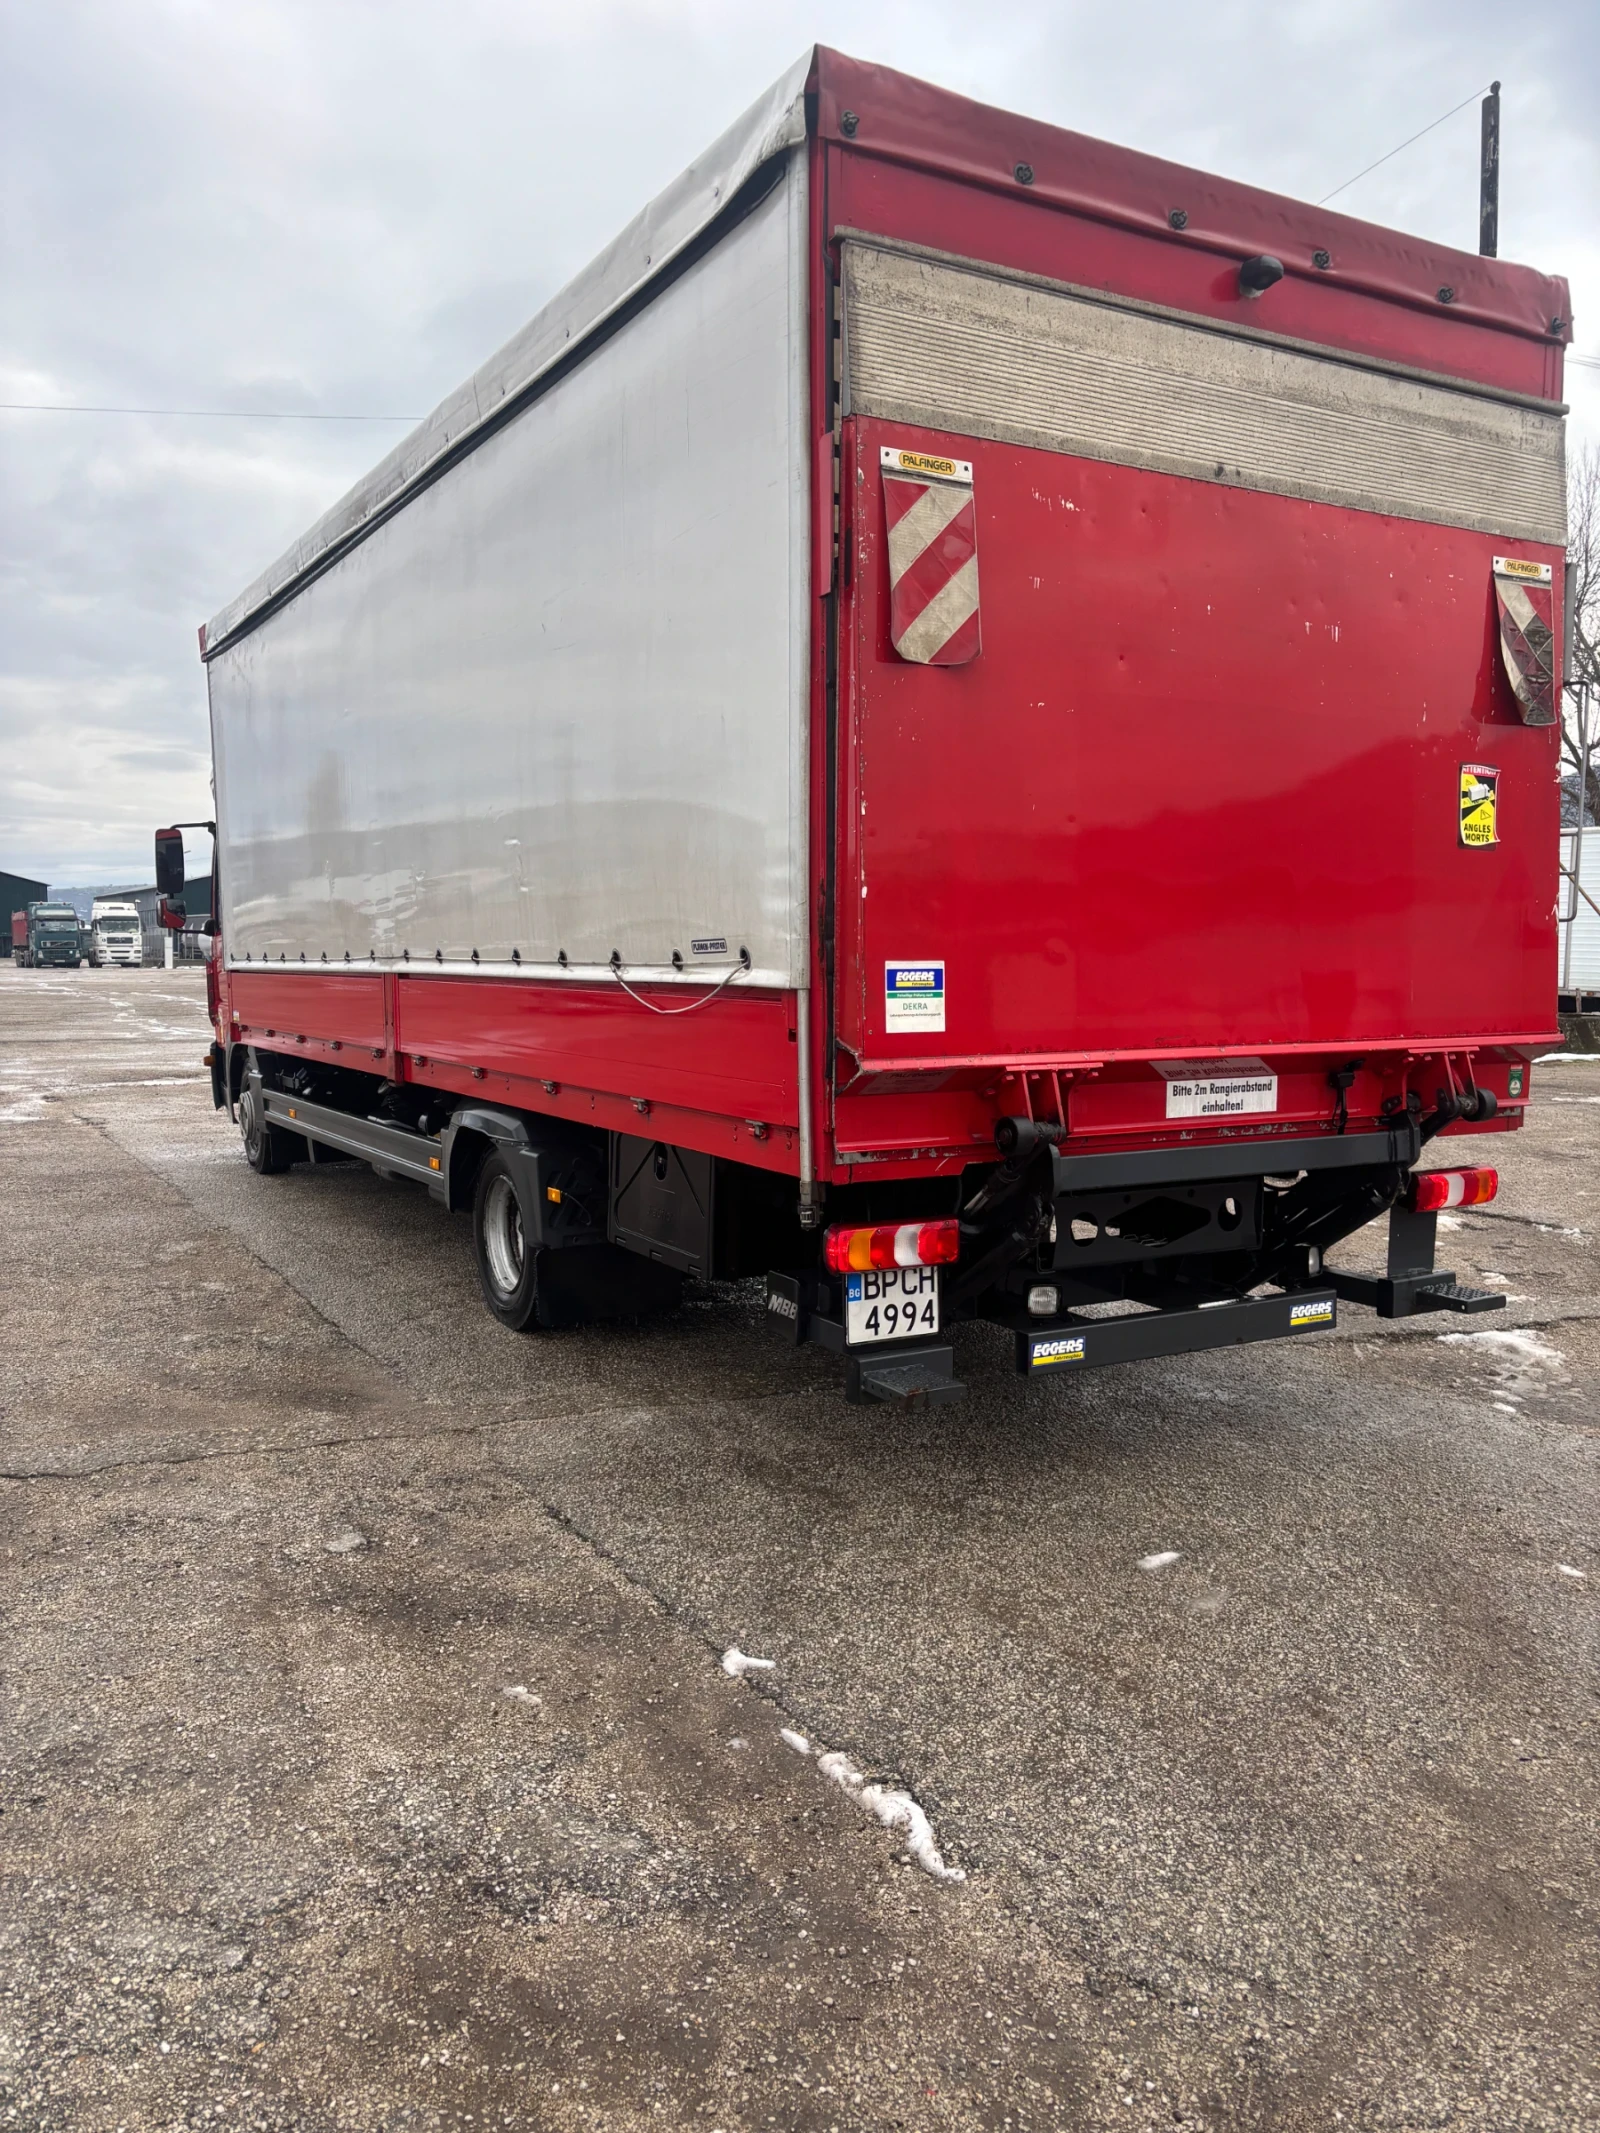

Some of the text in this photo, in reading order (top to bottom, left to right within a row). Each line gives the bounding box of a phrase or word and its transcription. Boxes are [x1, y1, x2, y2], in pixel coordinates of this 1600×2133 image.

[902, 454, 952, 472] PALFINGER
[1506, 561, 1539, 574] PALFINGER
[1464, 823, 1491, 833] ANGLES
[1465, 833, 1490, 842] MORTS
[896, 971, 935, 981] EGGERS
[902, 1002, 928, 1011] DEKRA
[1172, 1079, 1272, 1096] Bitte 2m Rangierabstand
[1202, 1099, 1244, 1112] einhalten!
[848, 1288, 861, 1298] BG
[1290, 1301, 1333, 1318] EGGERS
[865, 1299, 935, 1336] 4994
[1032, 1338, 1084, 1357] EGGERS
